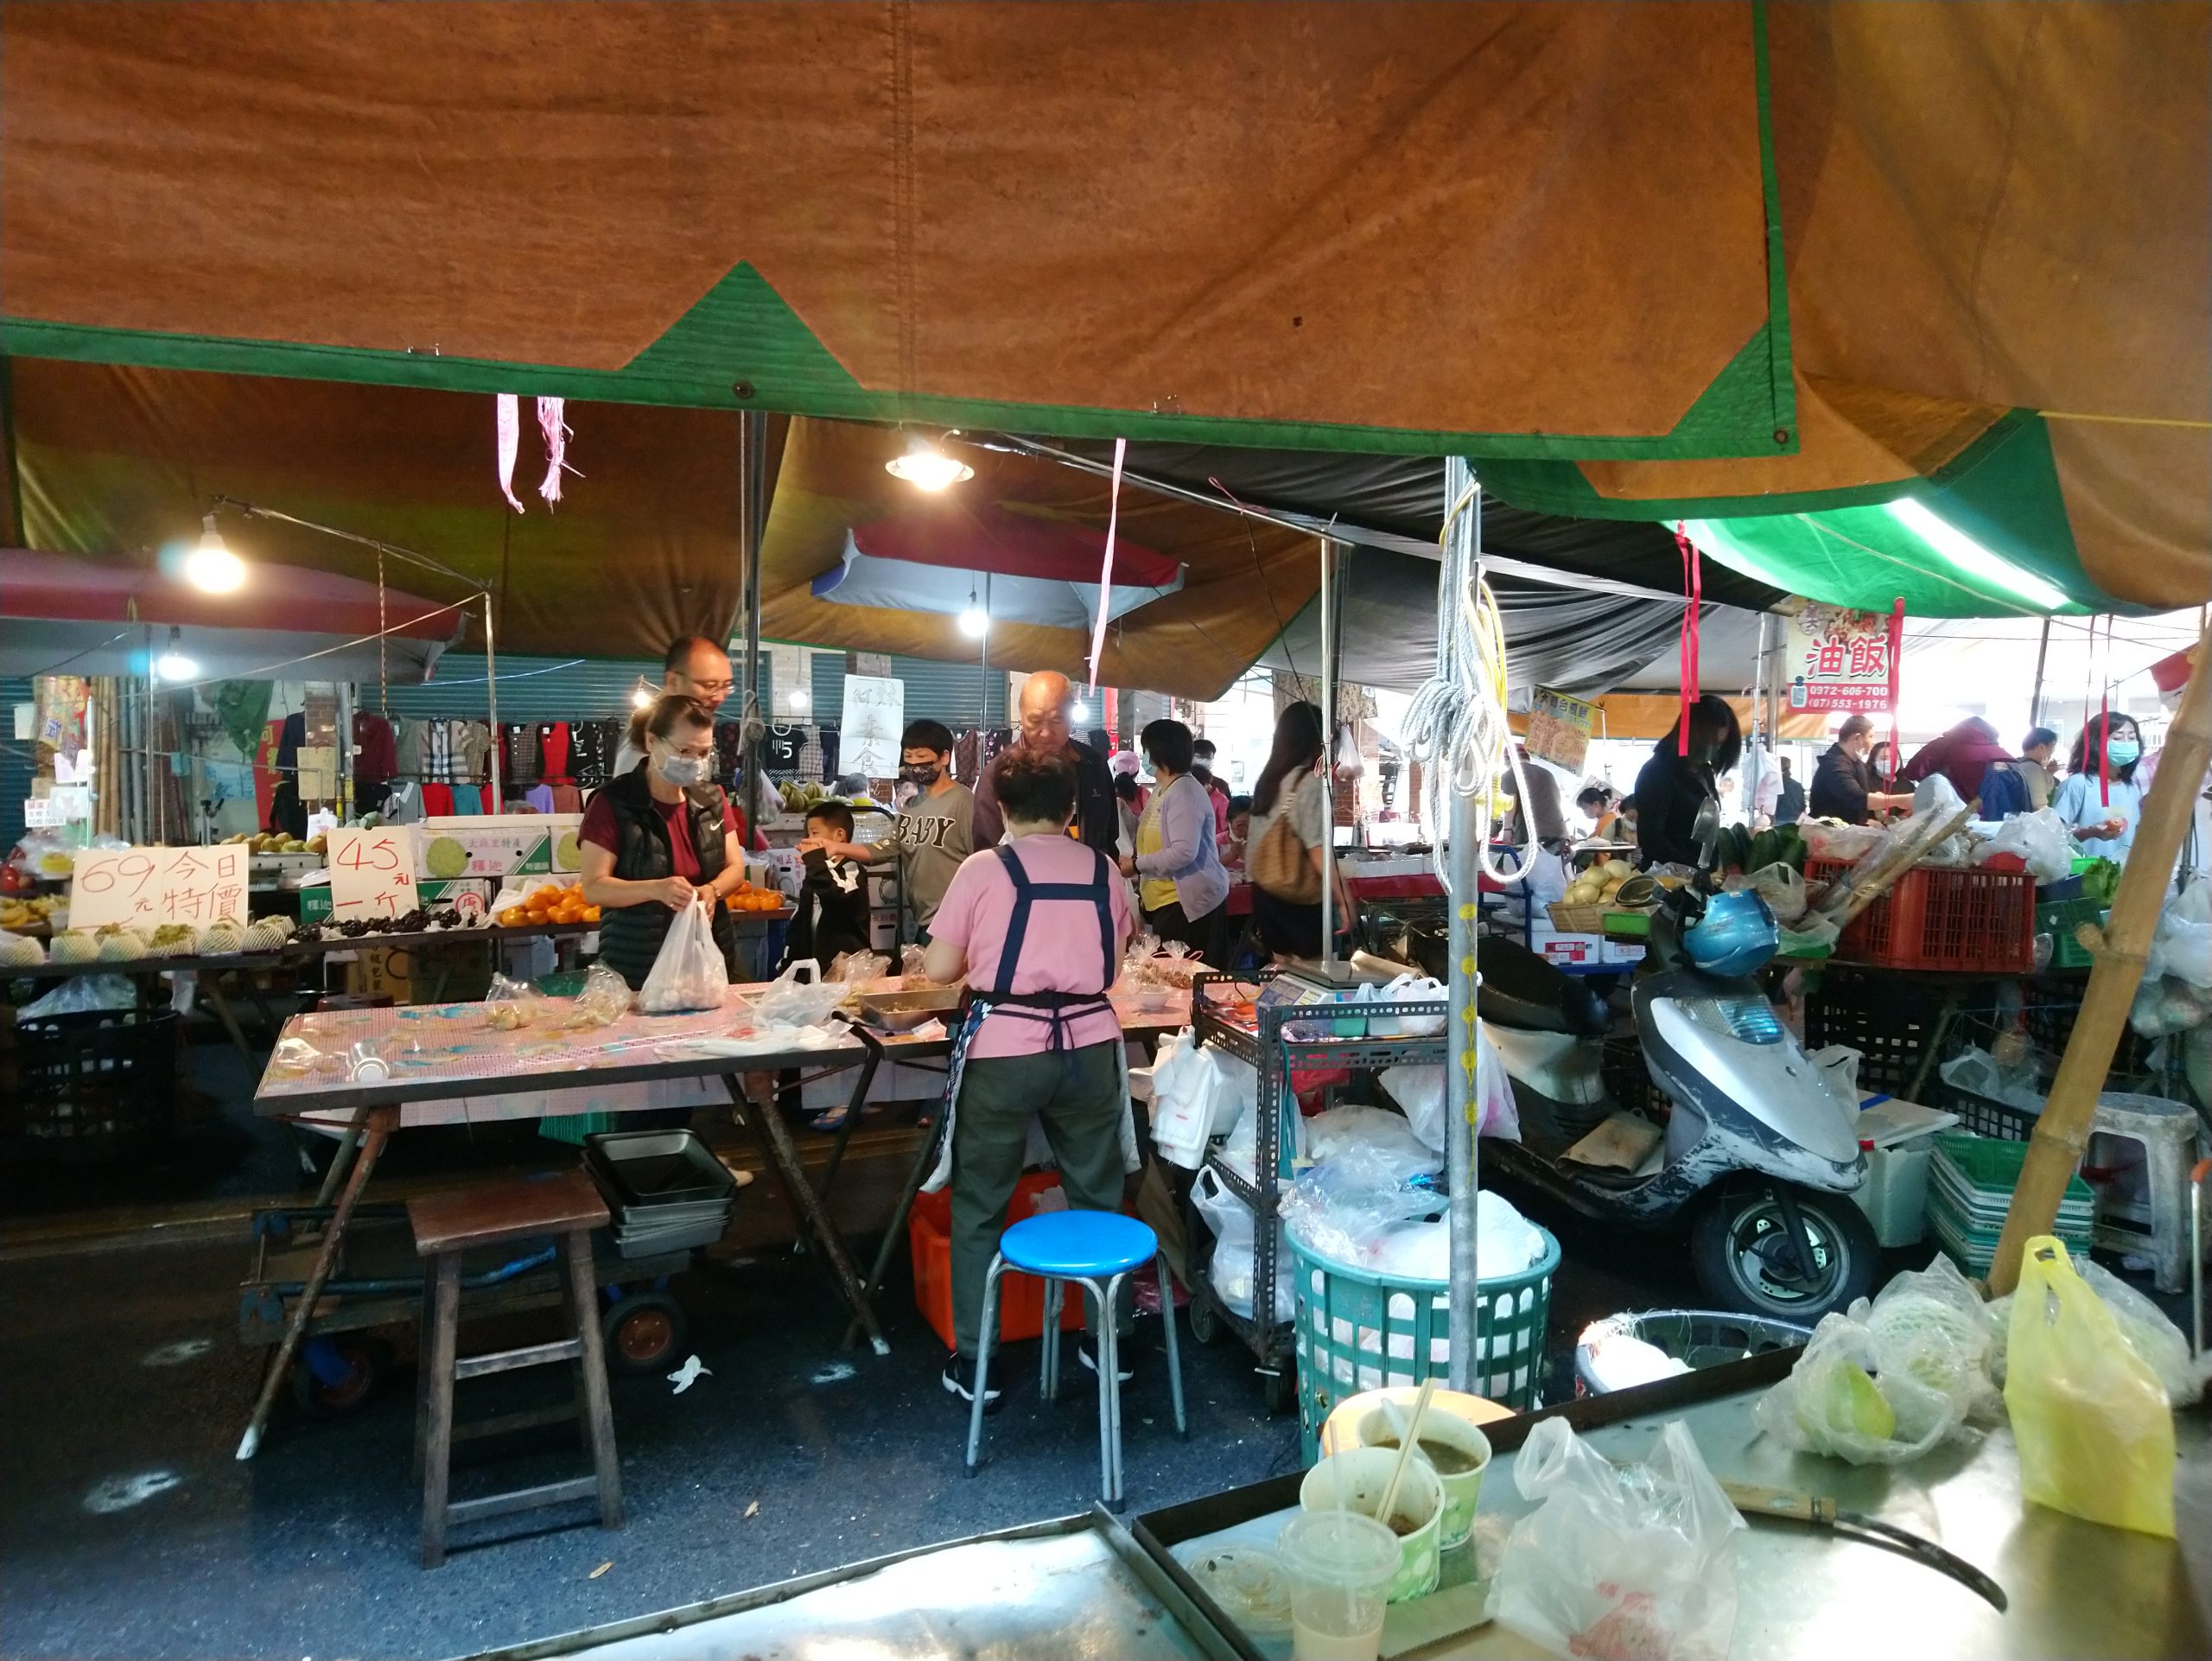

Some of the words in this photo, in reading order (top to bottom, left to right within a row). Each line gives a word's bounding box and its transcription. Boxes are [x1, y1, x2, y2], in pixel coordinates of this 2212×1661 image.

[1805, 633, 1887, 678] 油飯
[1808, 698, 1887, 710] (07)553-1976
[899, 813, 956, 848] BABY
[164, 851, 235, 880] 今日
[337, 837, 398, 870] 45
[80, 855, 155, 898] 69
[393, 873, 410, 886] 元
[135, 898, 153, 912] 元
[162, 882, 243, 920] 特價
